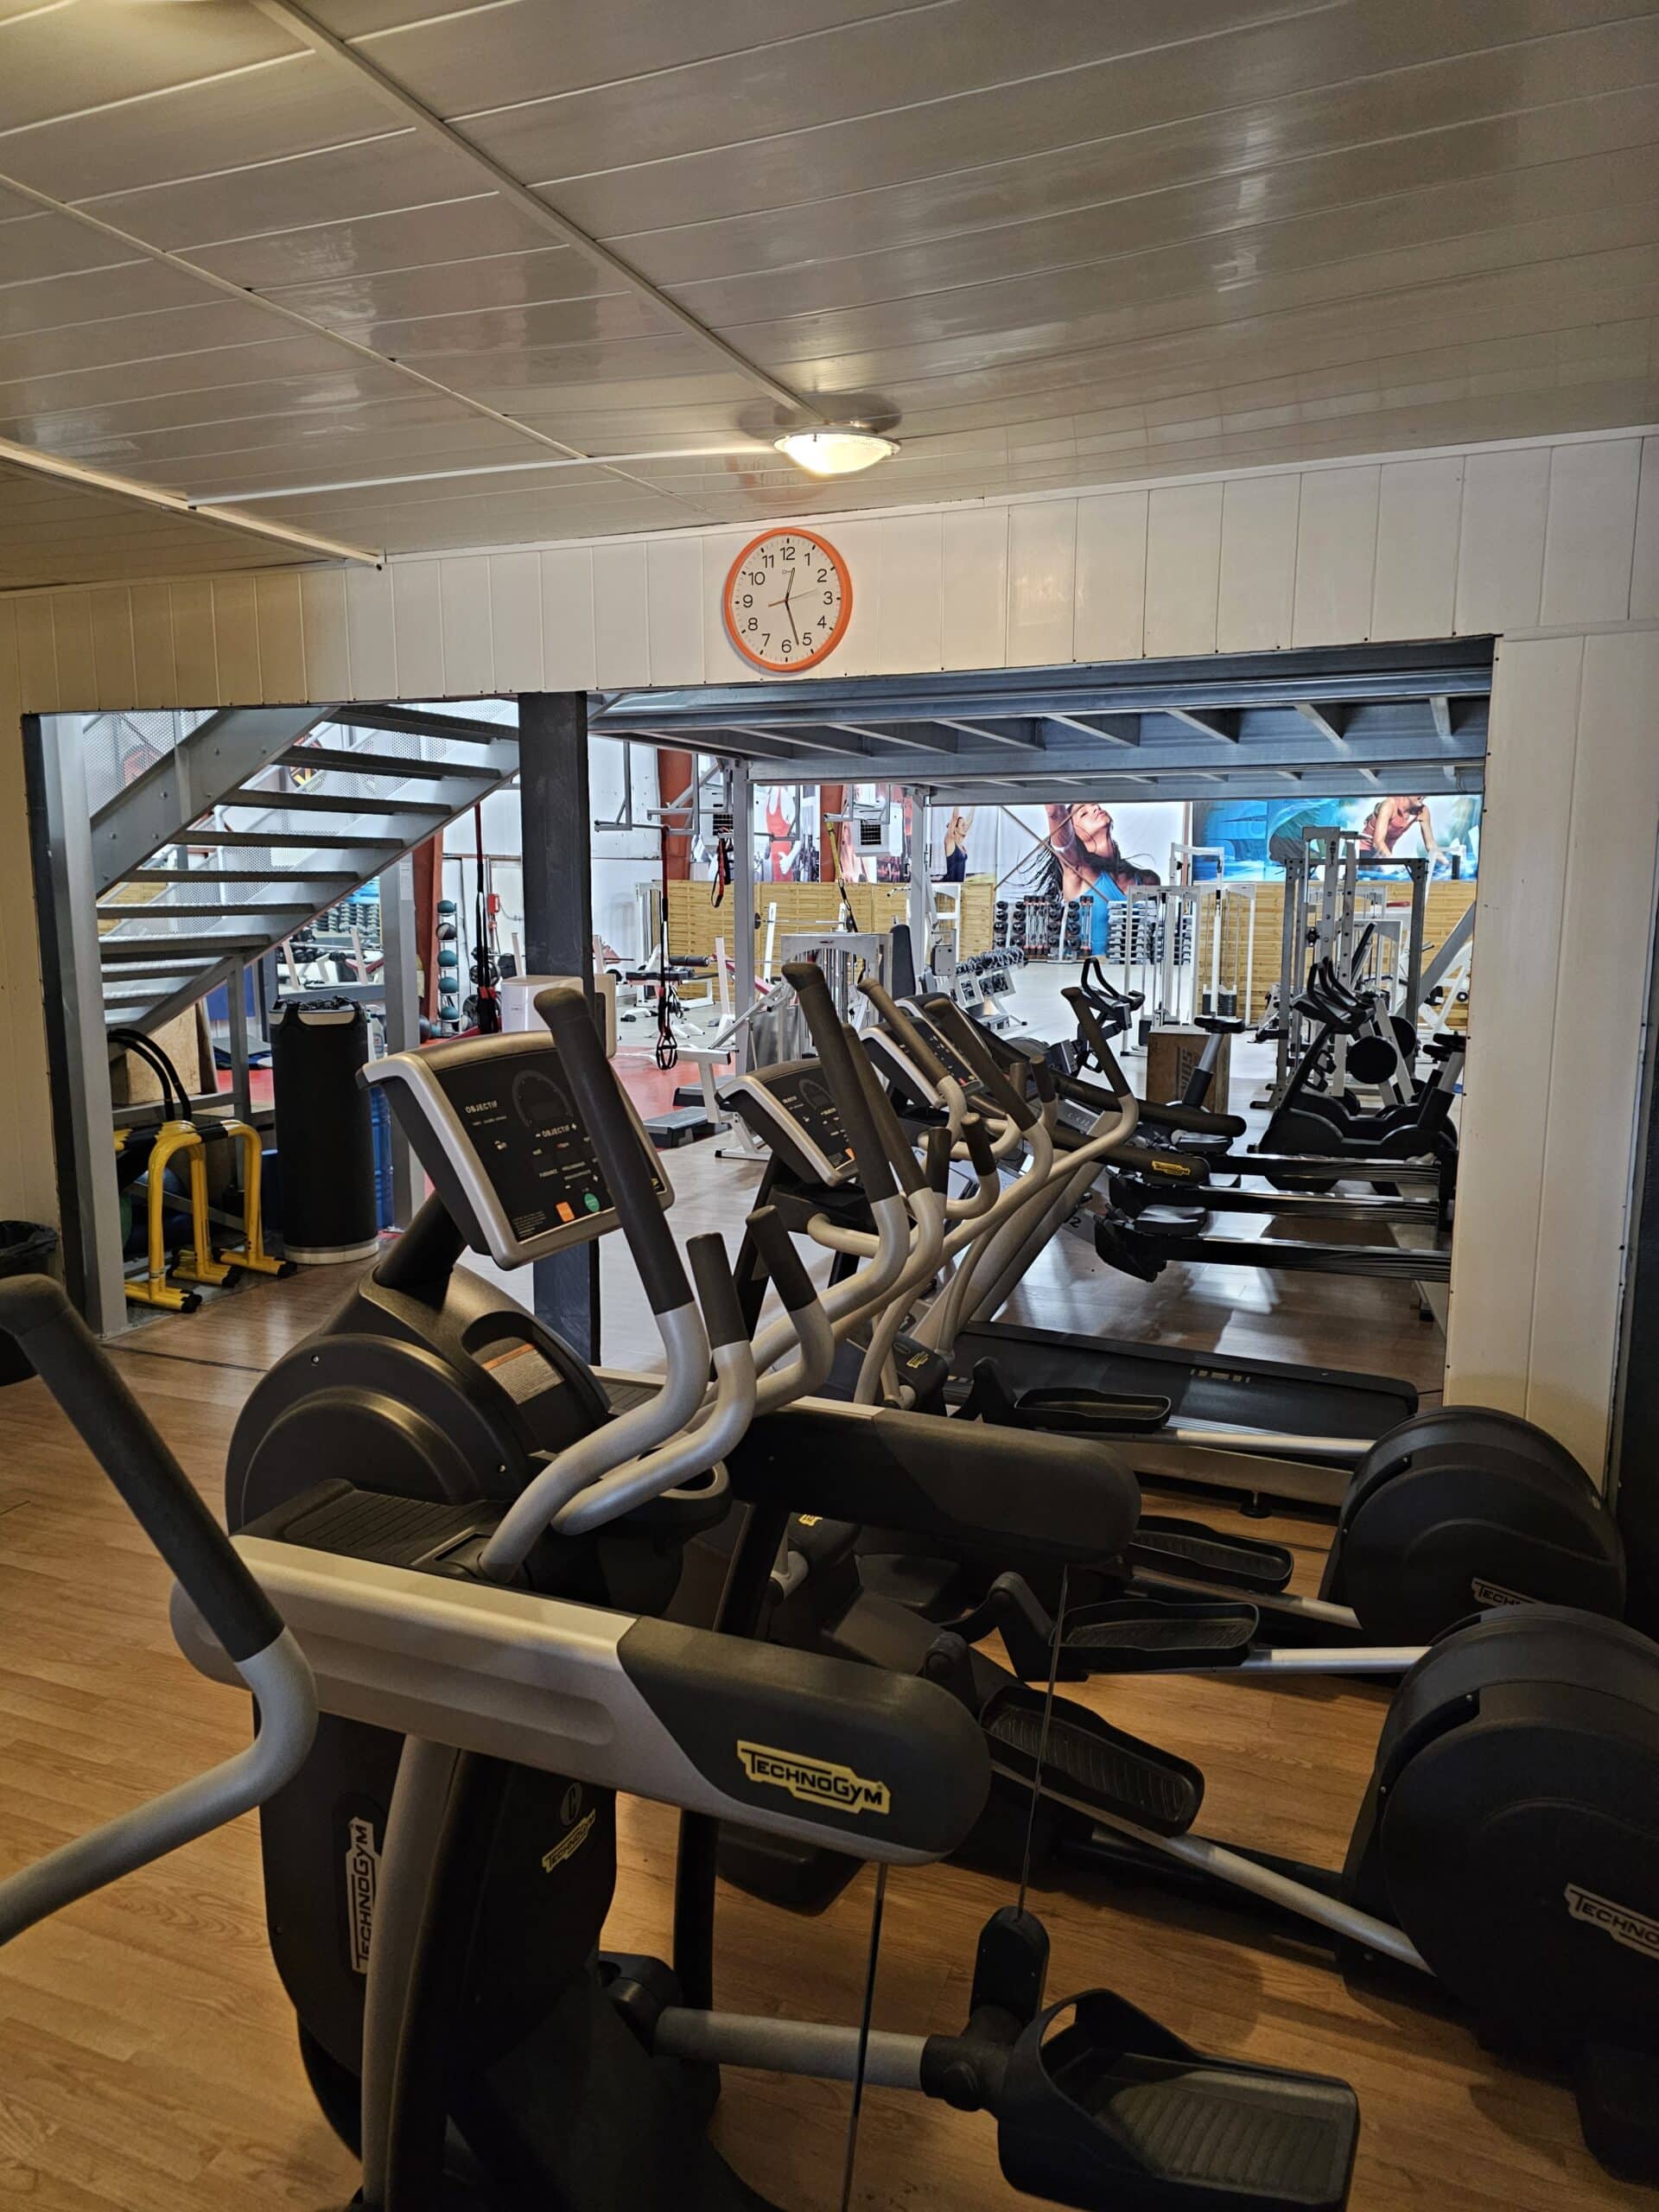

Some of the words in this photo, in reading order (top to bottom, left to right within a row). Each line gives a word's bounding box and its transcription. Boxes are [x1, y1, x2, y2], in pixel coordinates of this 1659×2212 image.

[779, 546, 796, 561] 12
[804, 553, 810, 567] 1
[761, 555, 775, 569] 11
[747, 571, 766, 586] 10
[817, 569, 828, 582] 2
[742, 594, 753, 608] 9
[823, 591, 833, 605] 3
[747, 617, 759, 631] 8
[817, 615, 827, 629] 4
[761, 633, 771, 647] 7
[781, 639, 791, 653] 6
[802, 632, 812, 646] 5
[465, 1100, 499, 1114] OBJECTIF
[542, 1125, 570, 1137] OBJECTIF
[741, 1748, 883, 1805] TECHNOGYM
[351, 1825, 376, 1969] TECHNOGYM
